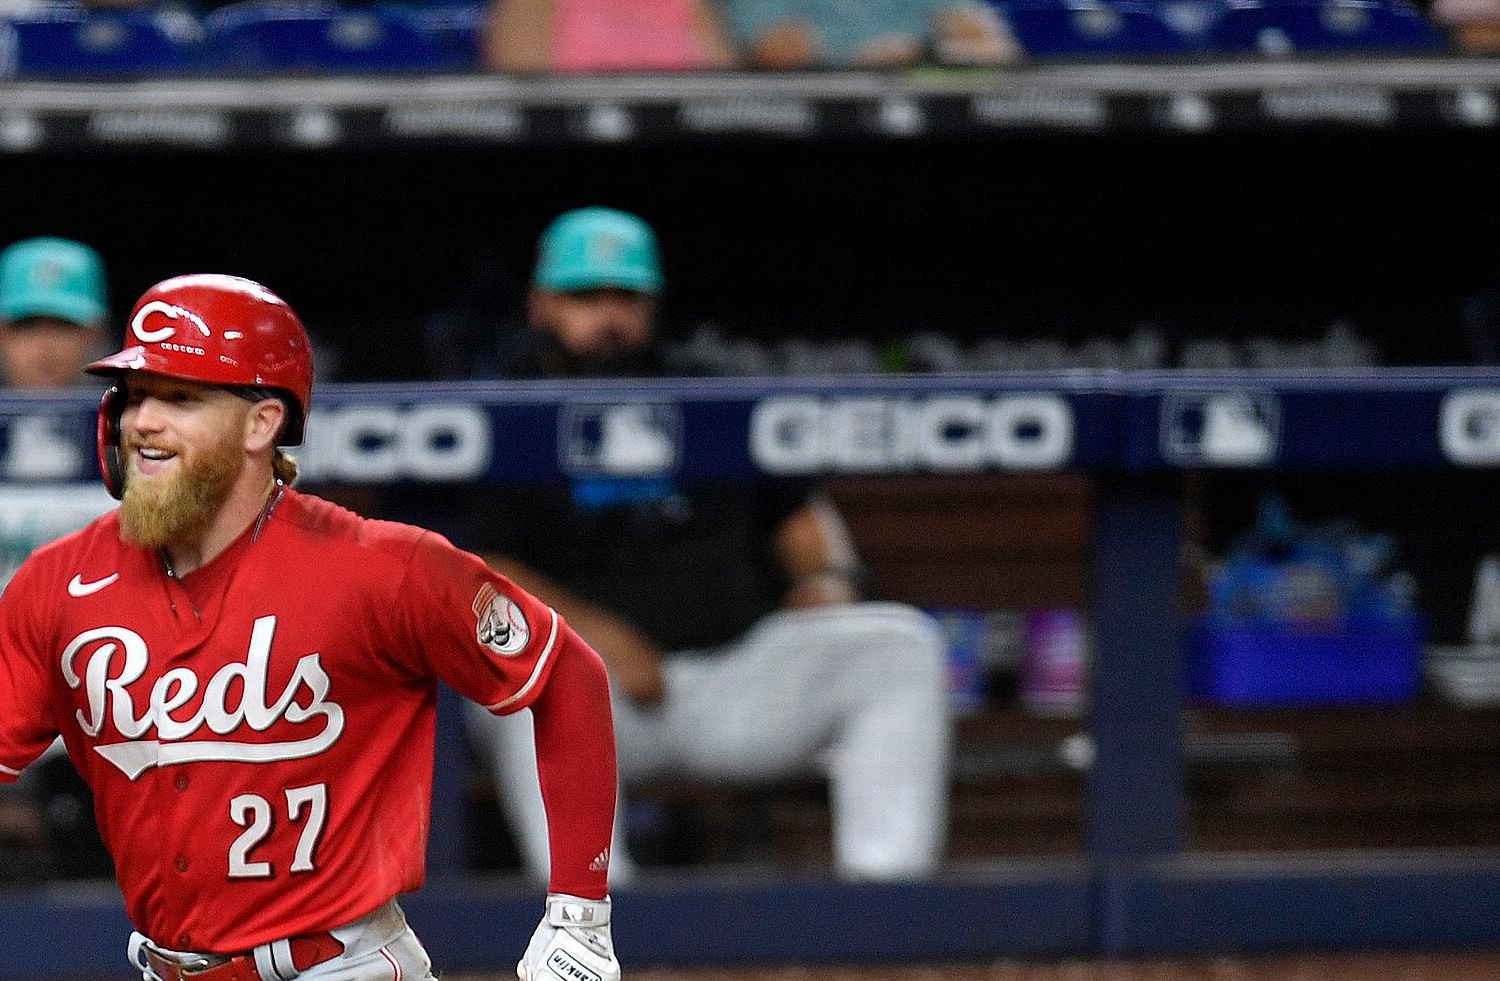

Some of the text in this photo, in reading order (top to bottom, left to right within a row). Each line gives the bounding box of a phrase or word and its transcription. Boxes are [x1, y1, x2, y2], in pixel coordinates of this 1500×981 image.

[750, 394, 1075, 476] GEICO
[60, 614, 346, 782] Reds
[227, 782, 329, 879] 27
